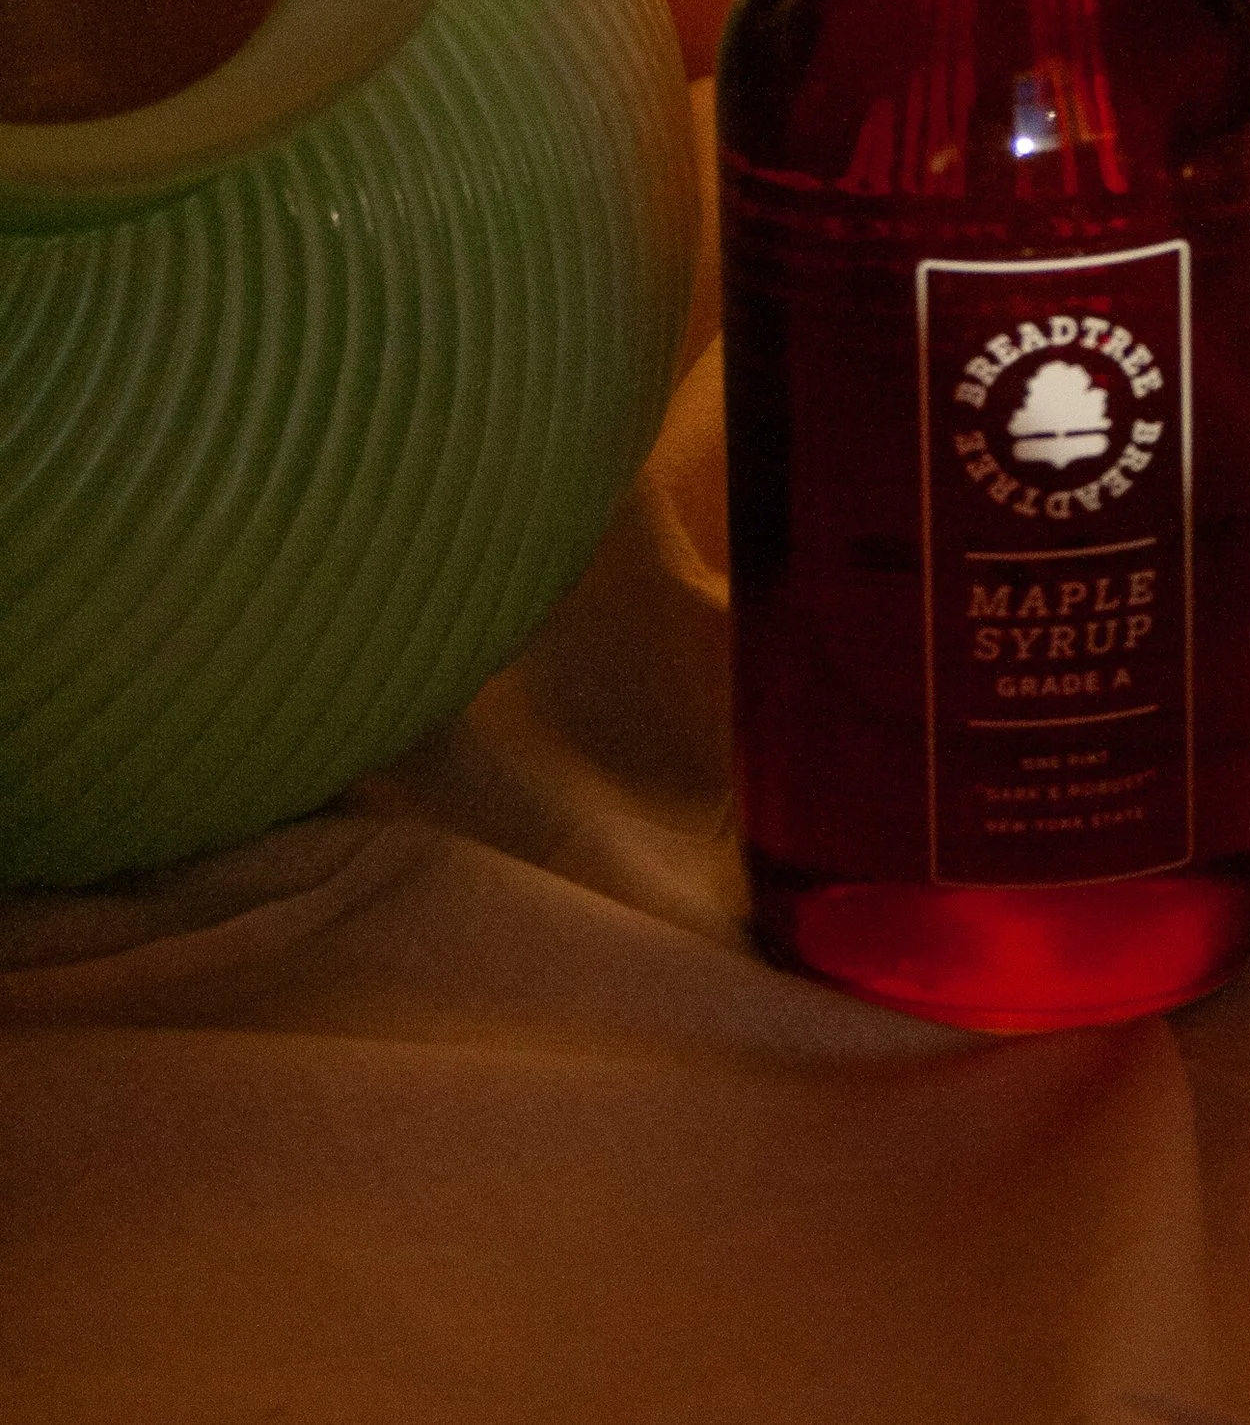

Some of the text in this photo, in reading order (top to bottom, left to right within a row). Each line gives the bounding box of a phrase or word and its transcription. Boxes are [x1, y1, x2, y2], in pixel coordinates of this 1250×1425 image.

[954, 315, 1164, 412] BREADTREE
[953, 418, 1164, 520] BREADTREE
[966, 570, 1157, 618] MAPLE
[973, 614, 1153, 661] SYRUP
[996, 667, 1132, 698] GRADE A
